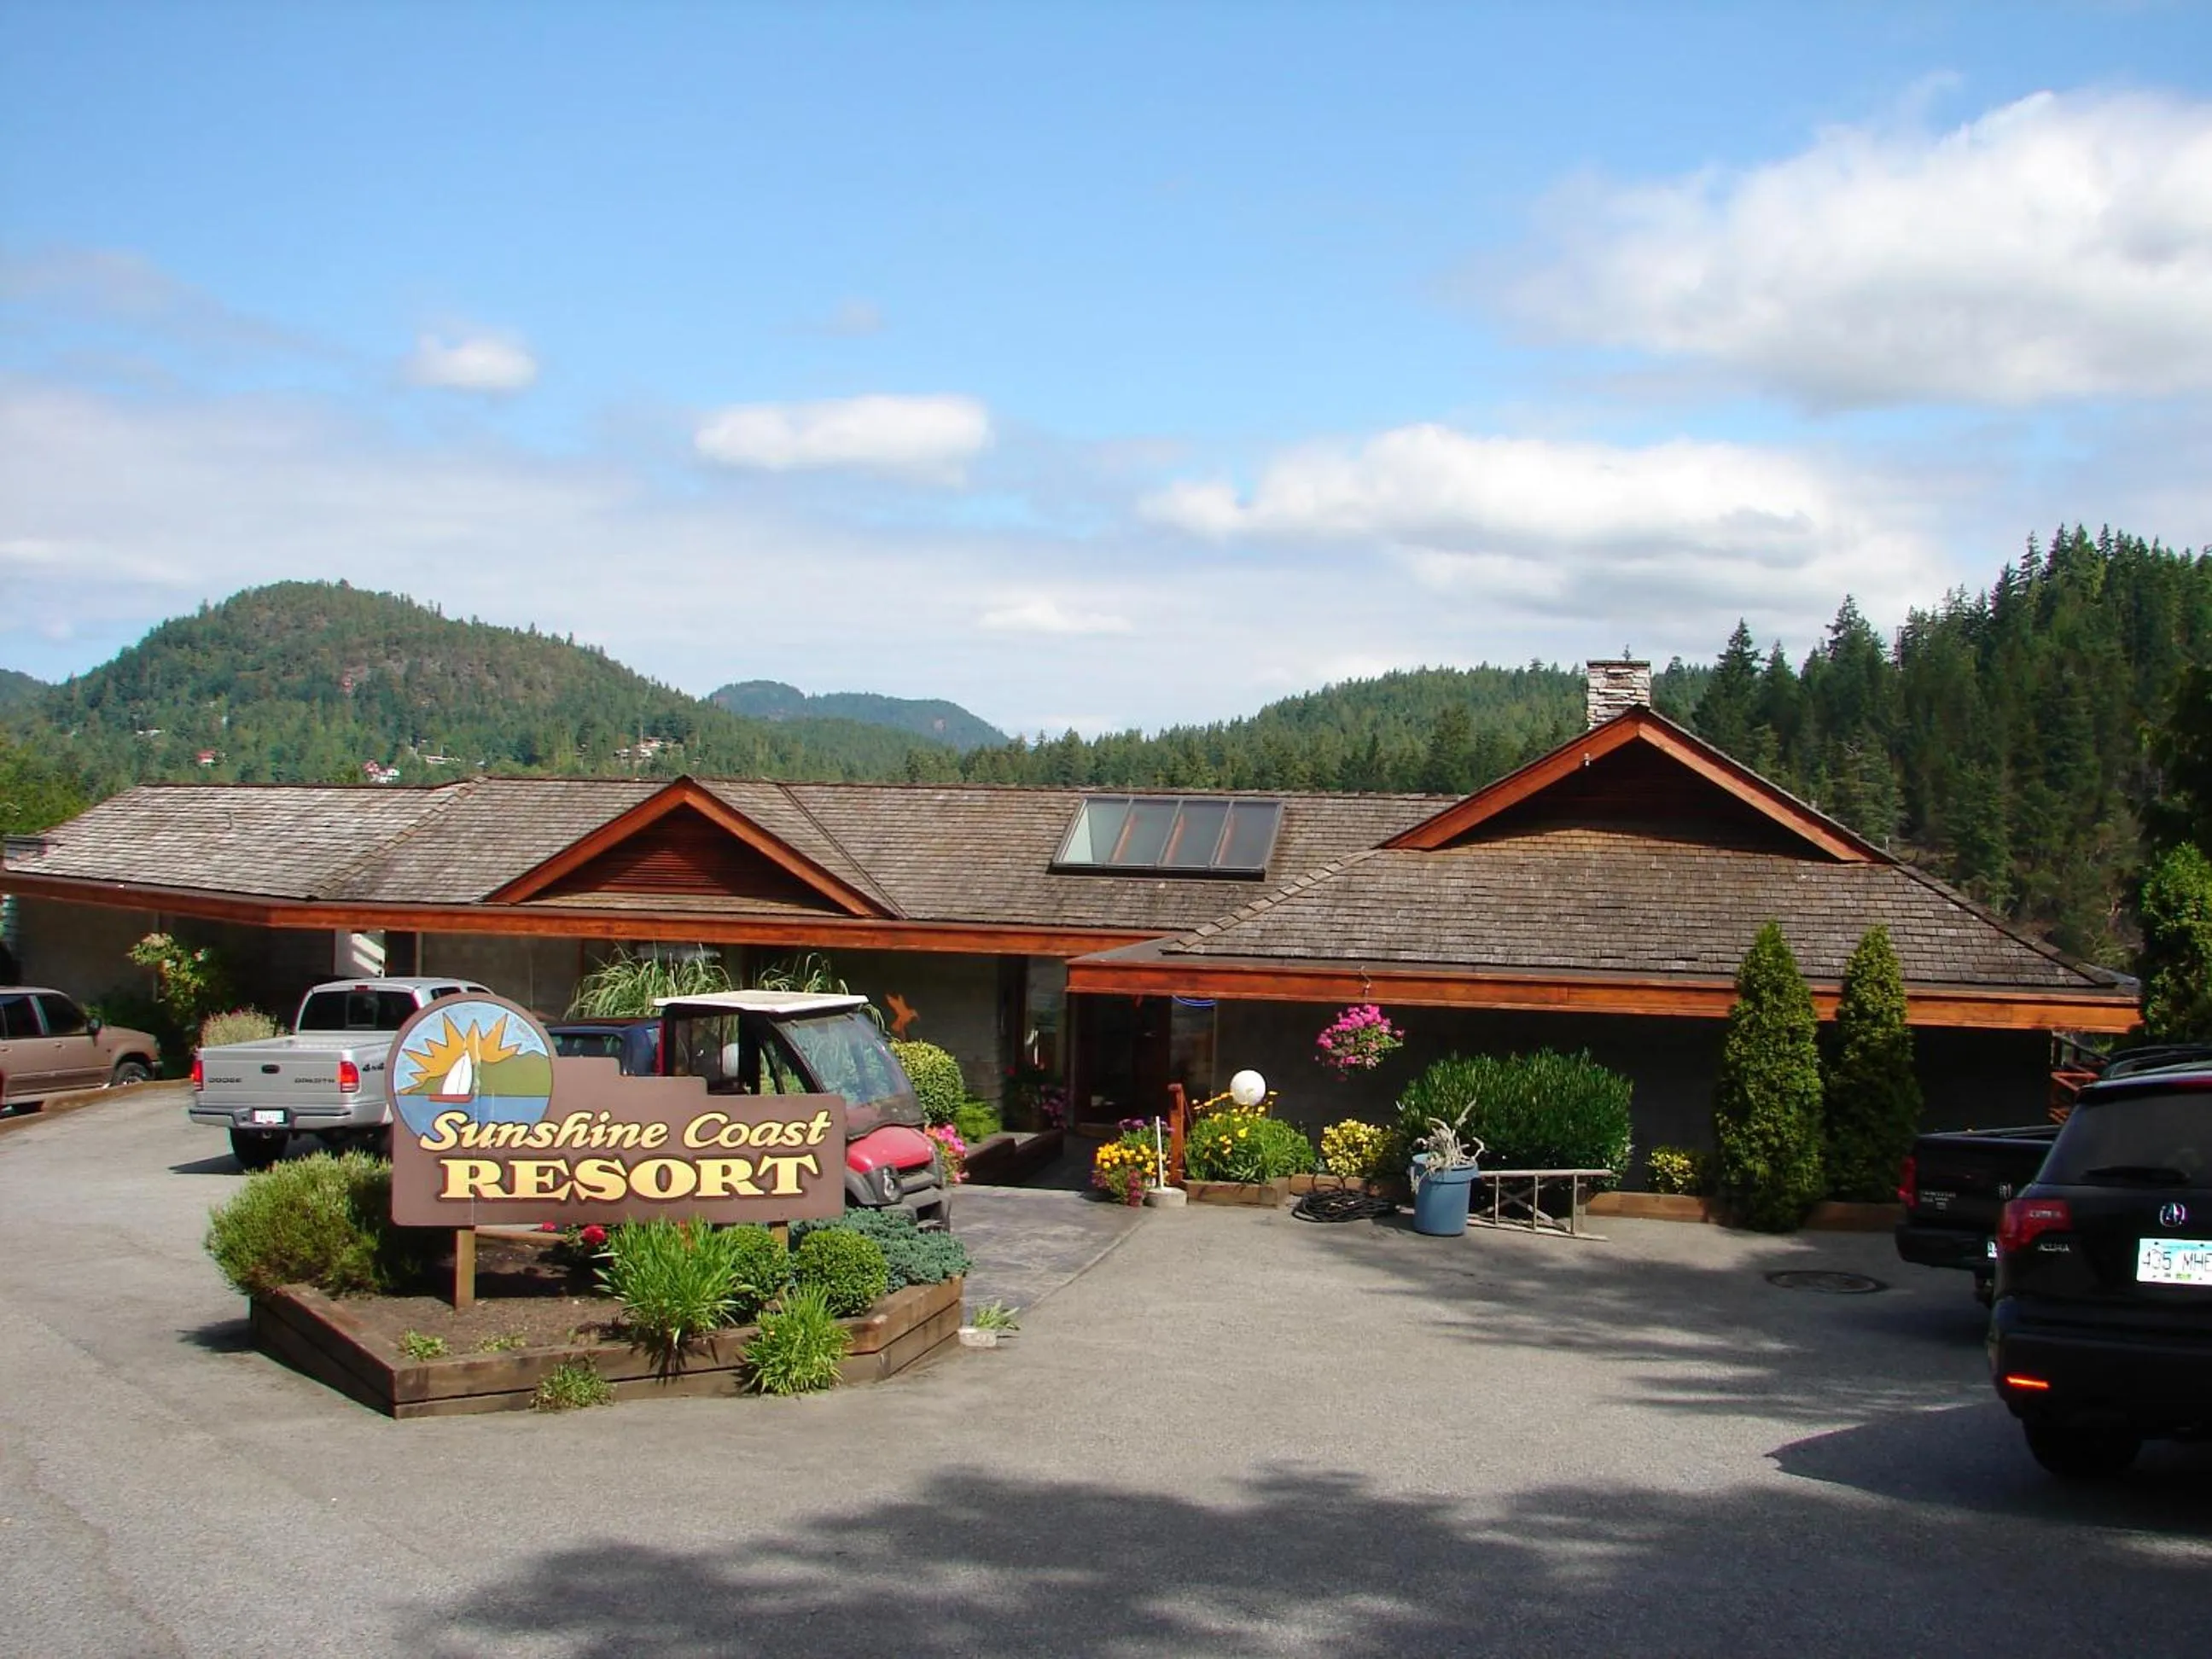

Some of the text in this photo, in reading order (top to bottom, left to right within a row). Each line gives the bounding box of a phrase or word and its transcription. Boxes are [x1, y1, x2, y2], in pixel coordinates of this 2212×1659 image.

[421, 1109, 833, 1150] Sunshine Coast
[439, 1154, 819, 1202] RESORT
